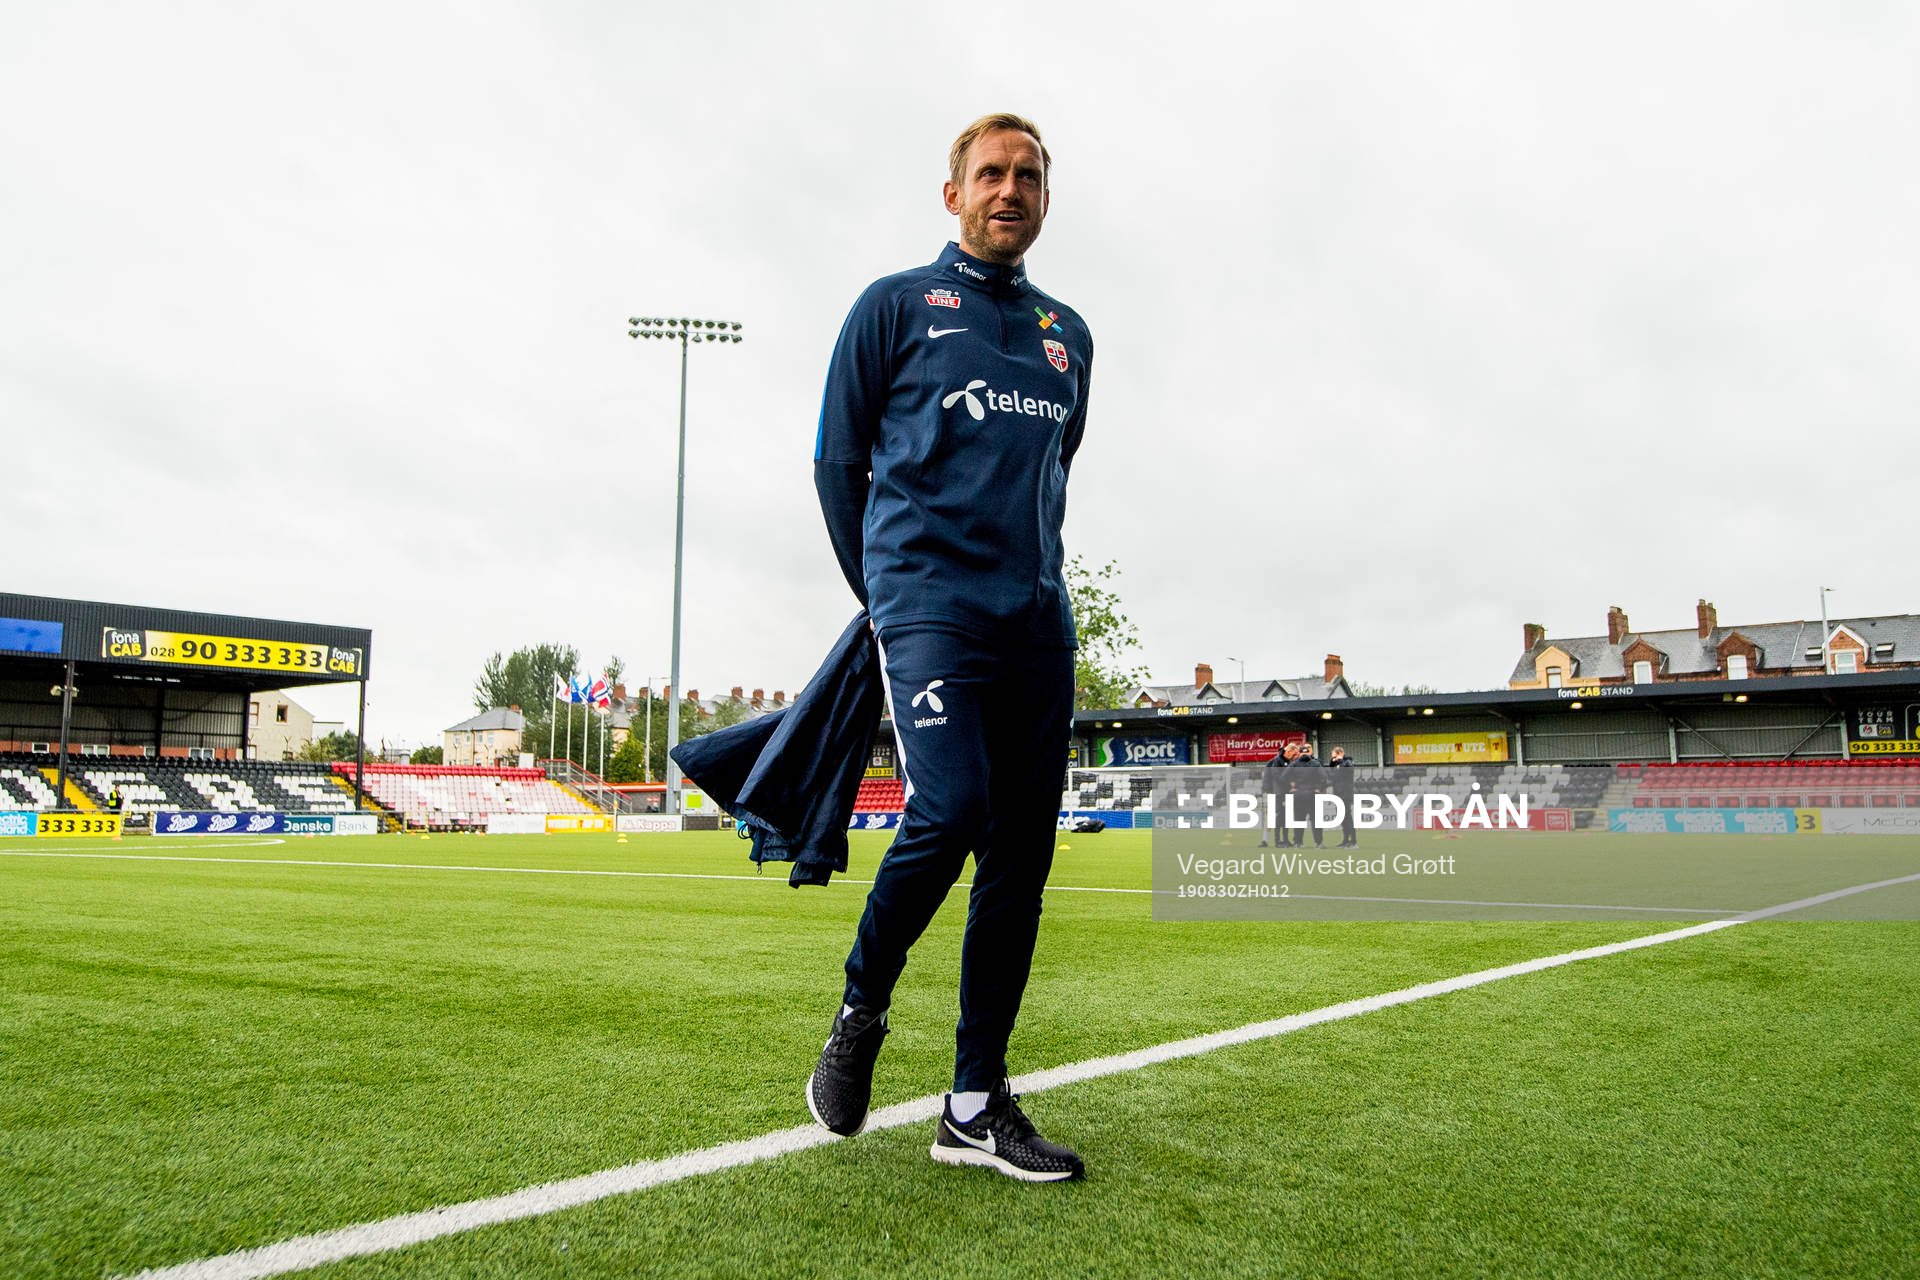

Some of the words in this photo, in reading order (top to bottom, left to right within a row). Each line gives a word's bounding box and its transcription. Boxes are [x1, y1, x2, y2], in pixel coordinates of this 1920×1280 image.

[963, 266, 987, 282] telenor
[930, 297, 958, 306] TINE
[985, 388, 1069, 425] telenor
[111, 631, 140, 645] fona
[109, 643, 143, 657] CAB
[150, 646, 176, 658] 028
[181, 640, 217, 660] 90
[224, 643, 272, 664] 333
[278, 648, 323, 668] 333
[331, 647, 356, 662] fona
[328, 658, 356, 674] CAB
[914, 716, 948, 729] telenor
[1227, 739, 1254, 751] Harry
[1256, 738, 1285, 749] Corry
[1852, 743, 1870, 752] 90
[1873, 743, 1895, 752] 333
[39, 819, 76, 833] 333
[80, 819, 116, 833] 333
[283, 820, 331, 832] Danske
[338, 820, 369, 832] Bank
[639, 819, 676, 831] Kappa
[1863, 817, 1920, 827] McCo
